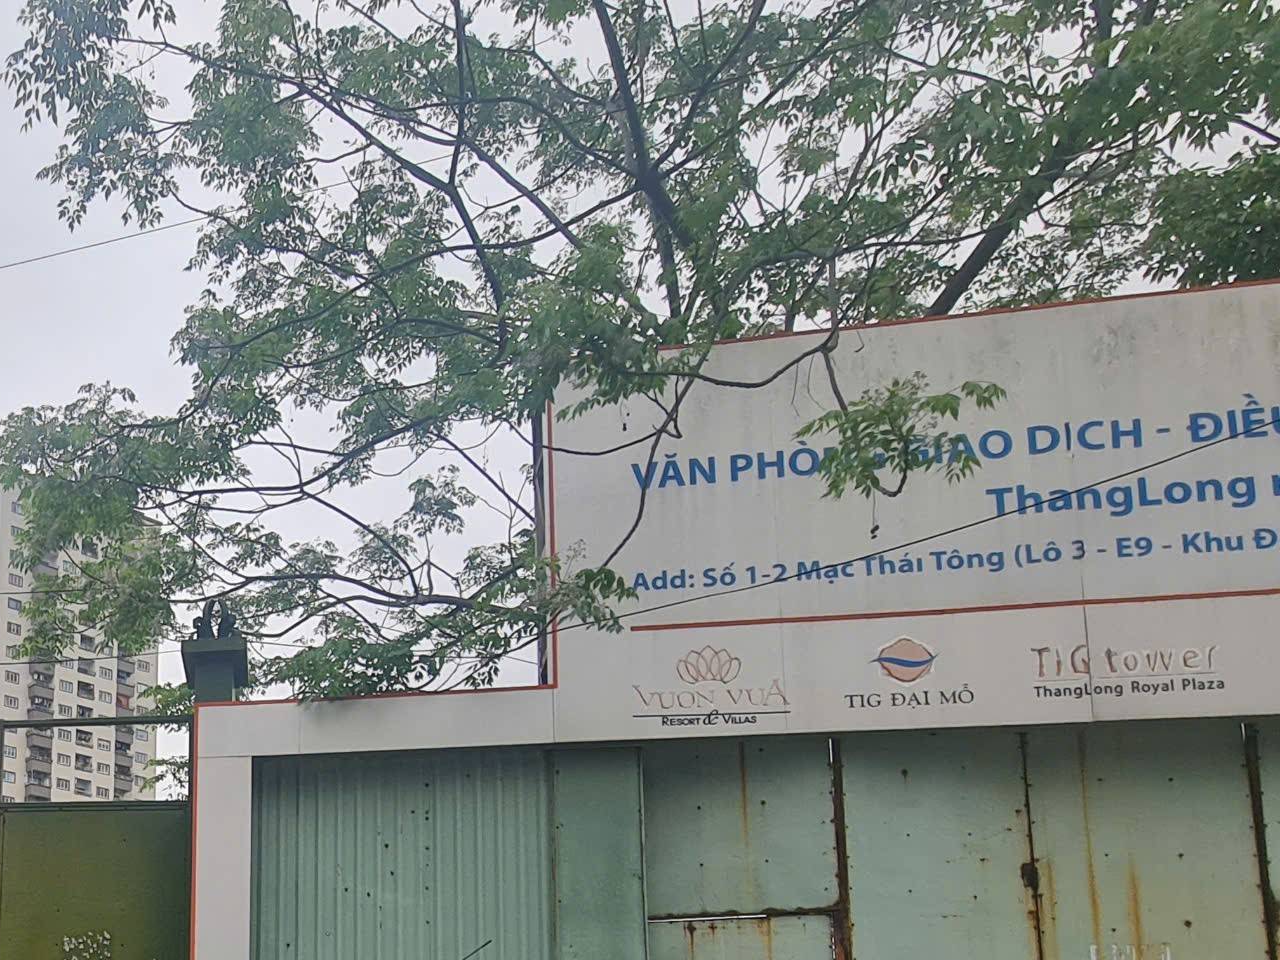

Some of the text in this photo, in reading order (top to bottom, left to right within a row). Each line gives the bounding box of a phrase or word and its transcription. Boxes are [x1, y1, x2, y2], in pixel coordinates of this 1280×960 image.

[631, 452, 717, 490] VĂN
[729, 440, 888, 482] PHÒ
[985, 474, 1257, 517] ThangLong
[633, 569, 695, 592] Add:
[703, 562, 737, 588] Số
[797, 559, 855, 584] Mạc
[929, 549, 1005, 572] Tông
[1014, 540, 1062, 567] (Lô
[1071, 540, 1086, 560] 3
[1115, 536, 1153, 558] E9
[1181, 531, 1244, 554] Khu
[844, 693, 881, 708] TIG
[890, 690, 930, 709] ĐẠI
[1034, 677, 1225, 698] ThangLong Royal Plaza
